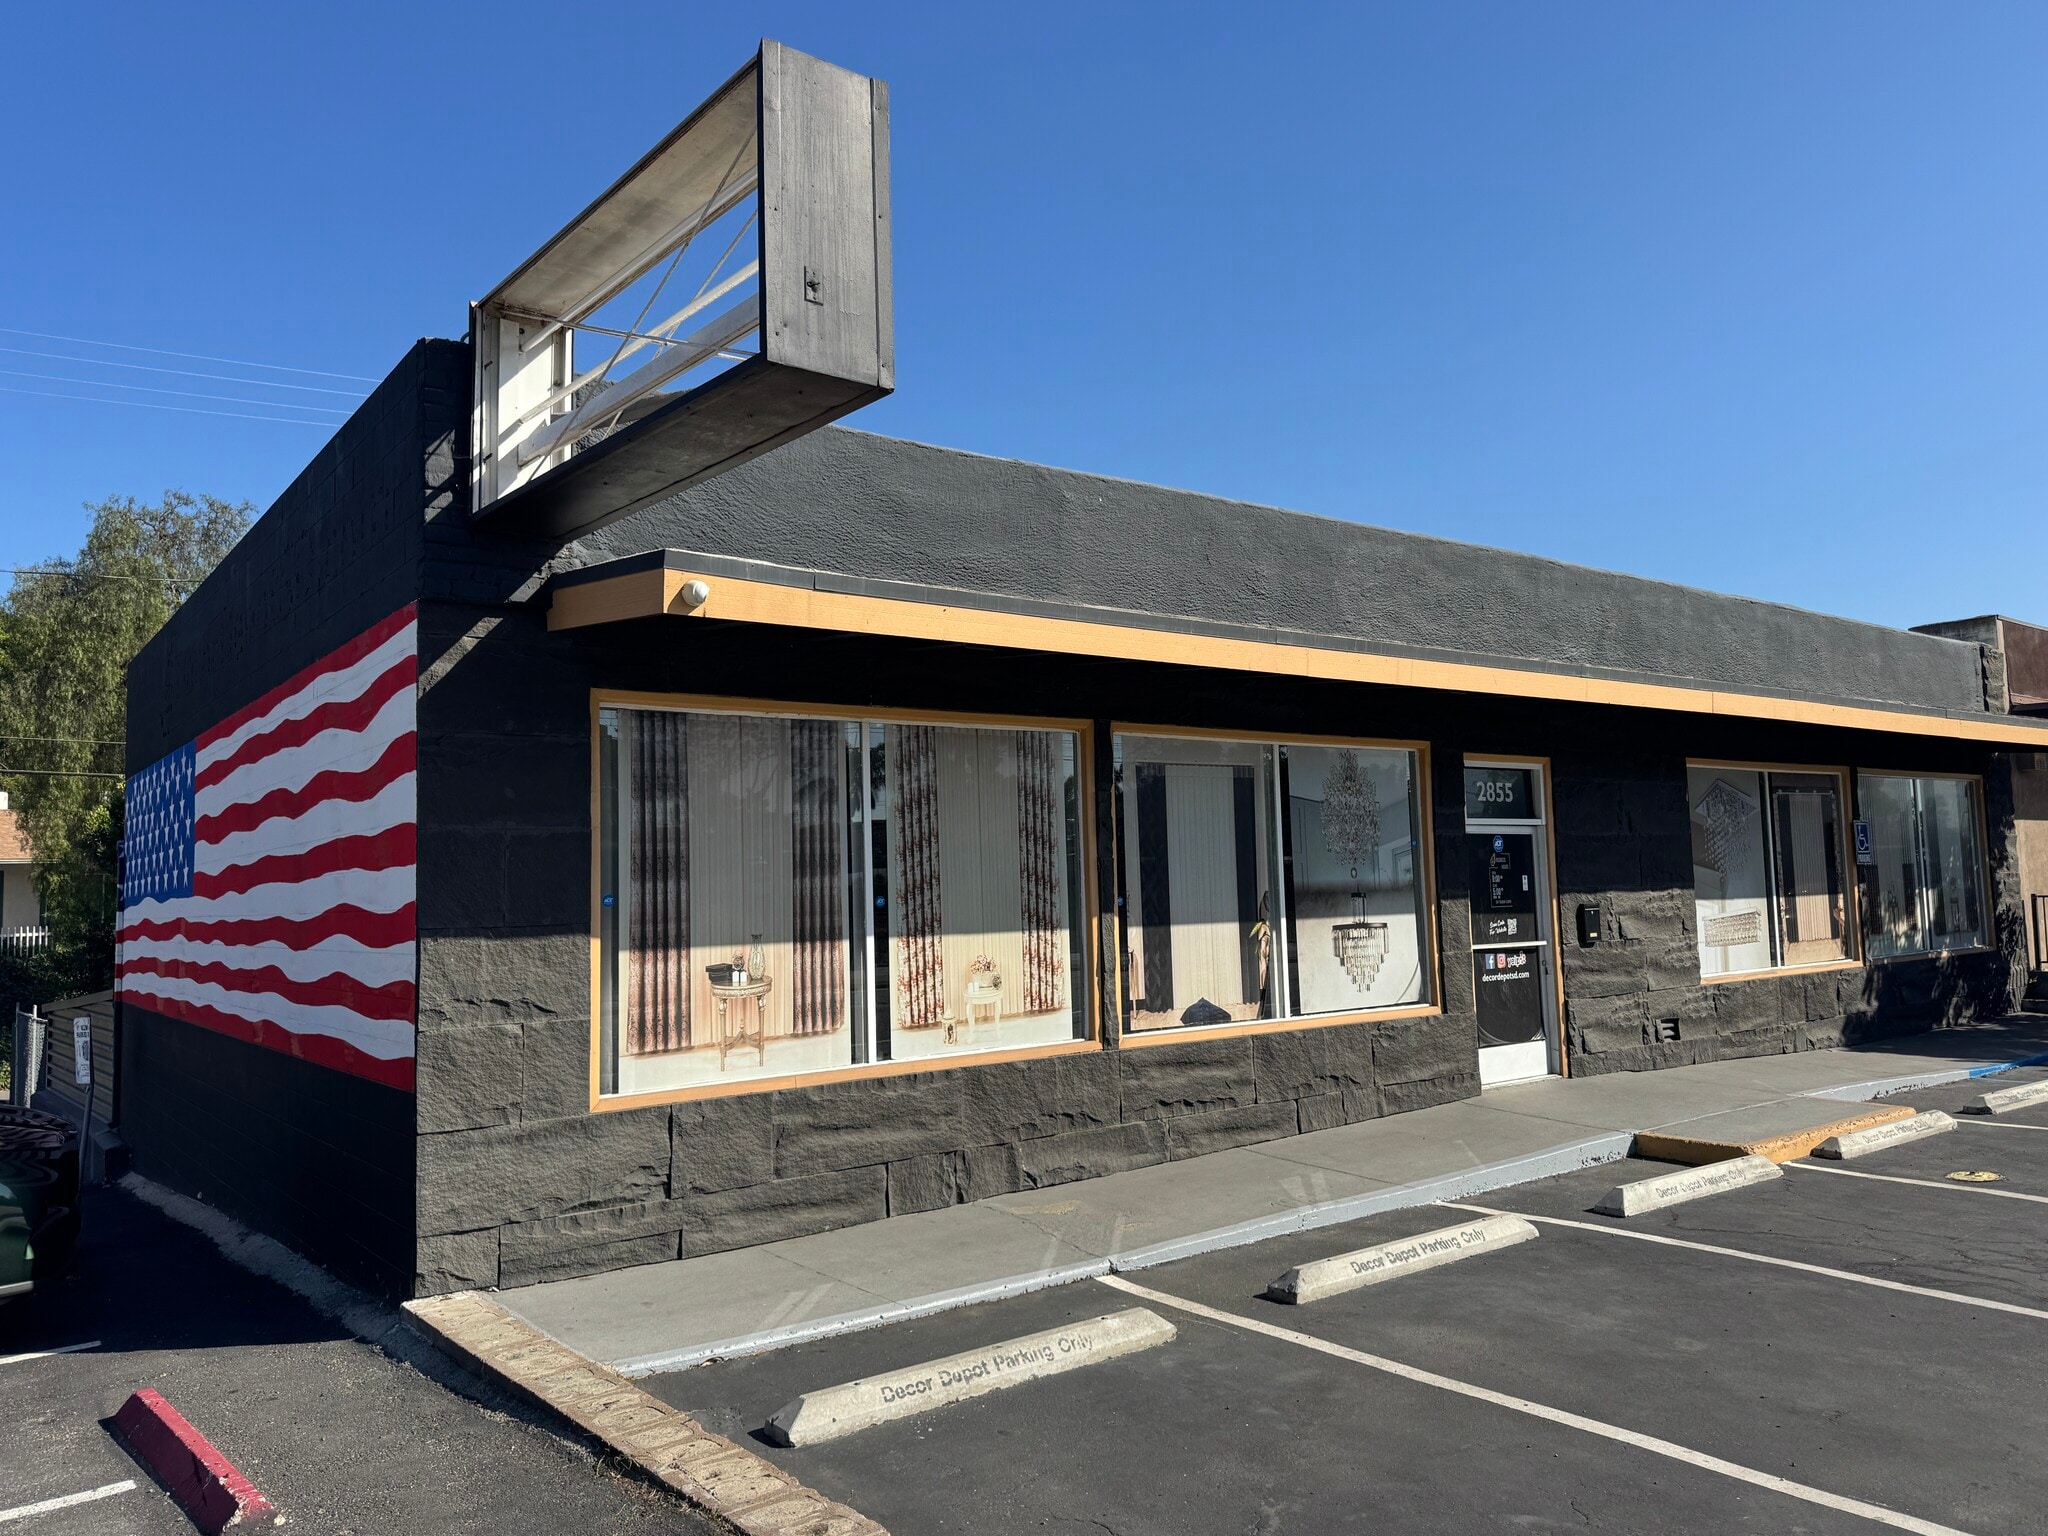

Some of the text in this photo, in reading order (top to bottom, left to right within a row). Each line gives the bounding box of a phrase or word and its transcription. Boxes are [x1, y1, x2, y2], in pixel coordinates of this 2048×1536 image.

[1476, 781, 1514, 803] 2855
[1482, 970, 1530, 982] decordepotsd.com
[1655, 1167, 1747, 1198] Decor Depot Parking Only
[1350, 1228, 1486, 1274] Decor Depot Parking Only
[880, 1333, 1093, 1403] Decor Depot Parking Only
